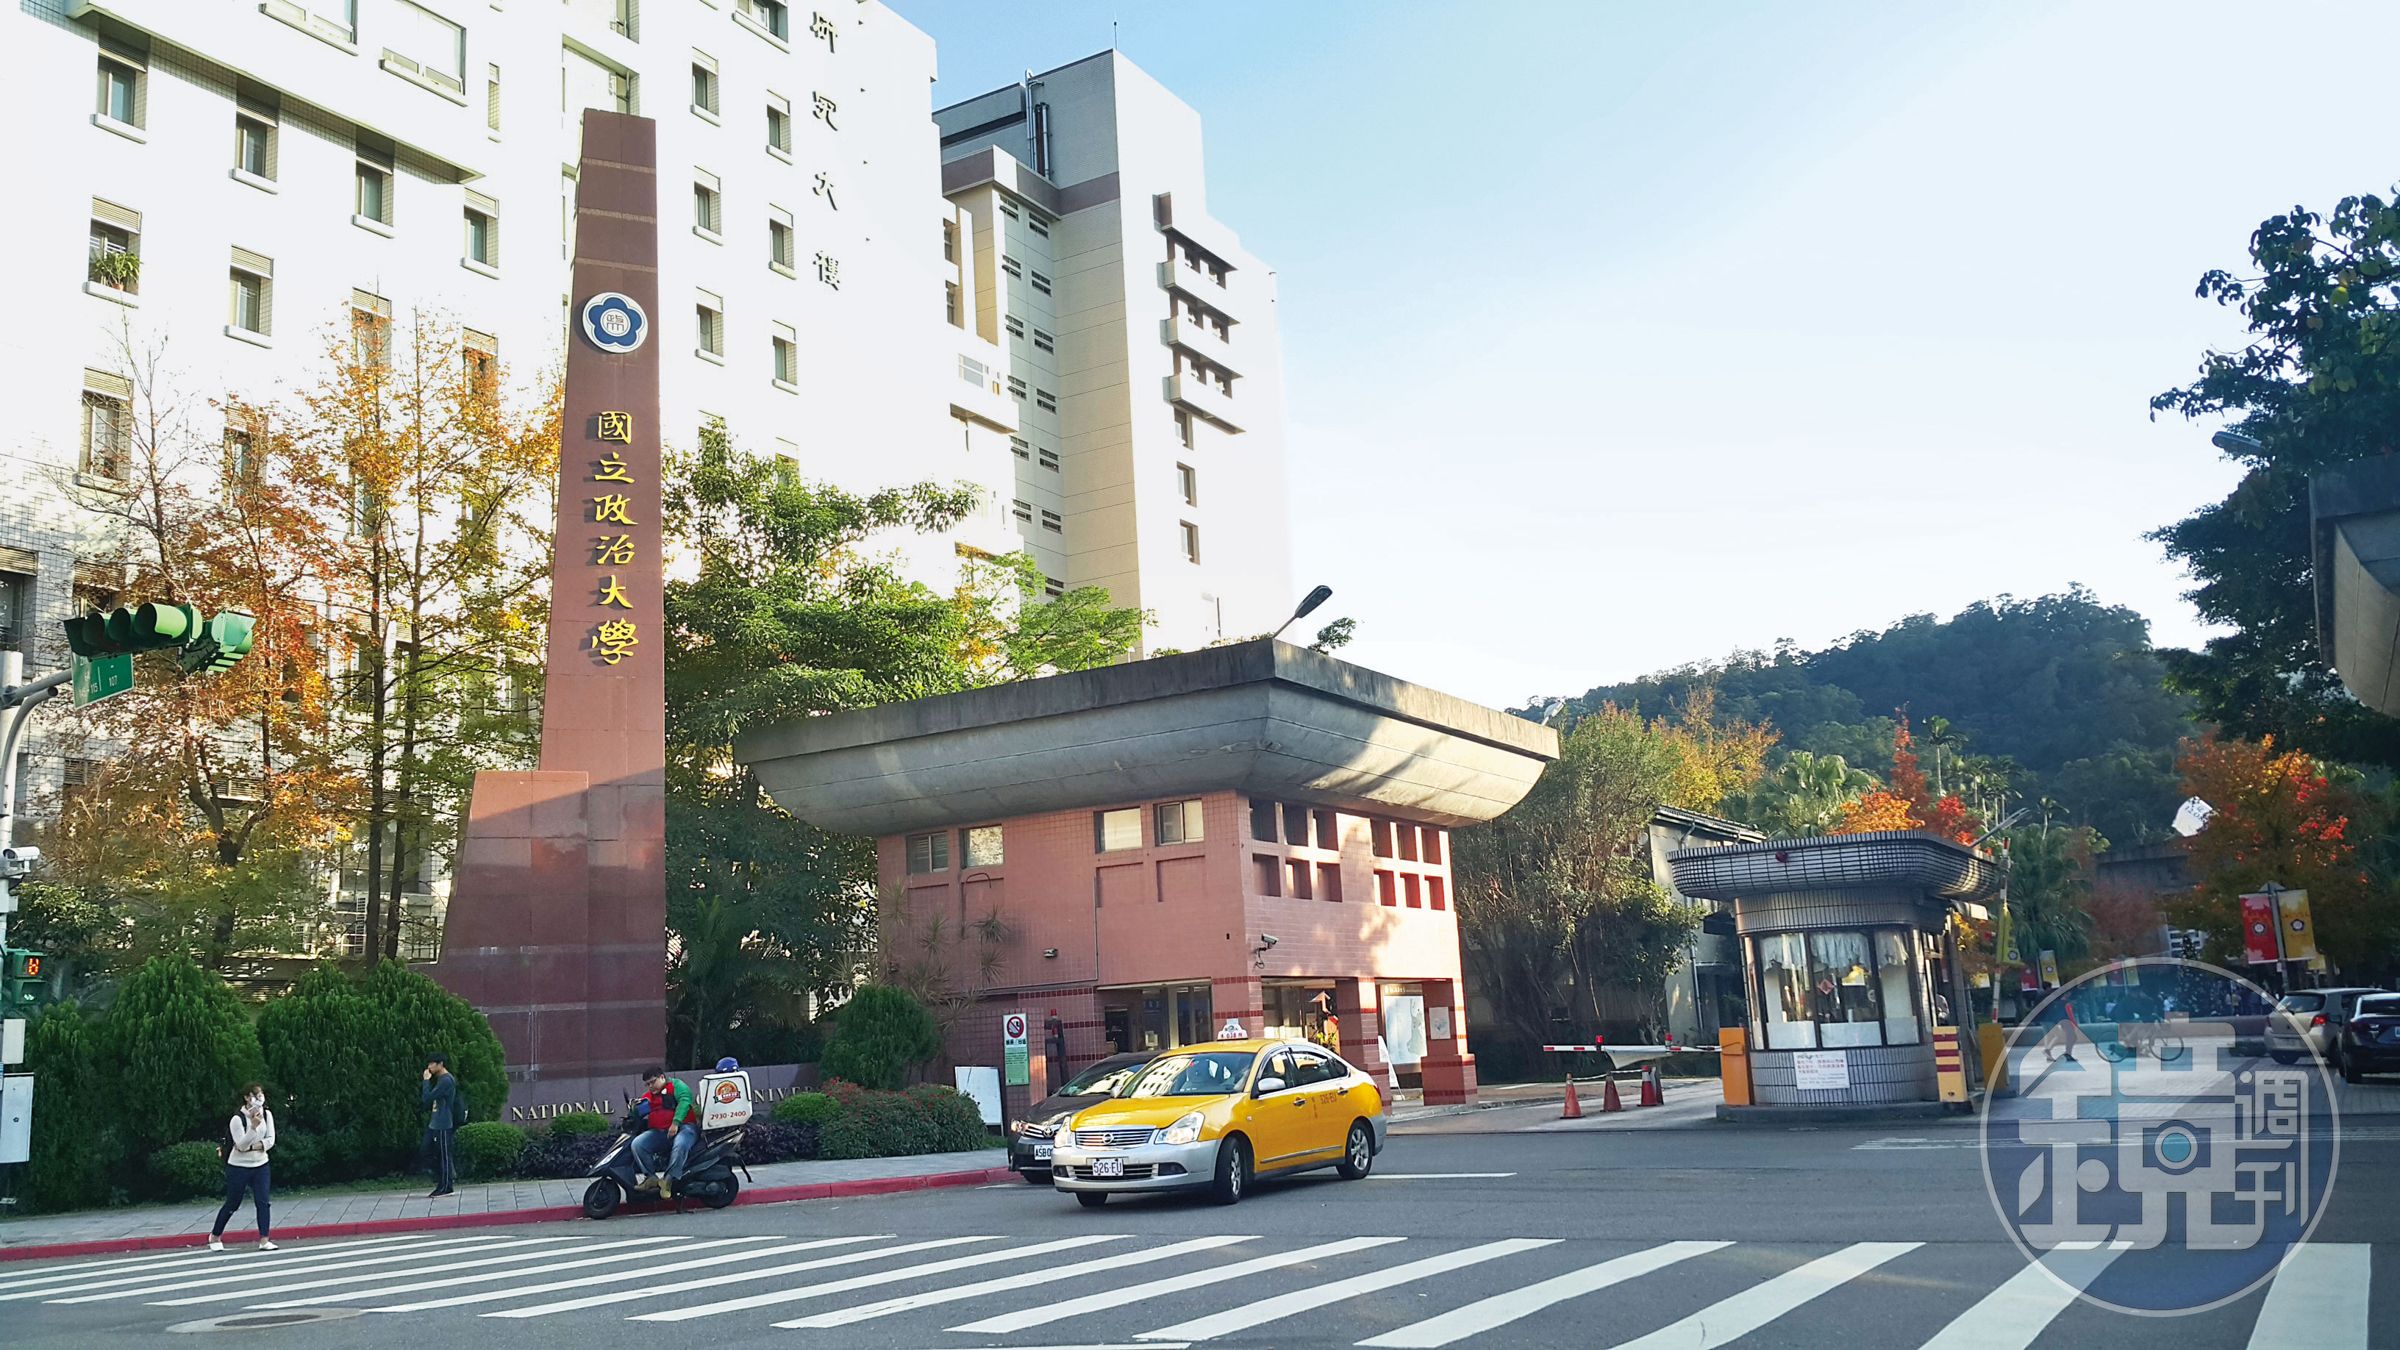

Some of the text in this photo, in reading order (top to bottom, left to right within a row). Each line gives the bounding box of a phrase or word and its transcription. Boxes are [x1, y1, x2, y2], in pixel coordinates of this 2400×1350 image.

[592, 411, 639, 665] 國立政治大學
[511, 1100, 615, 1122] NATIONAL
